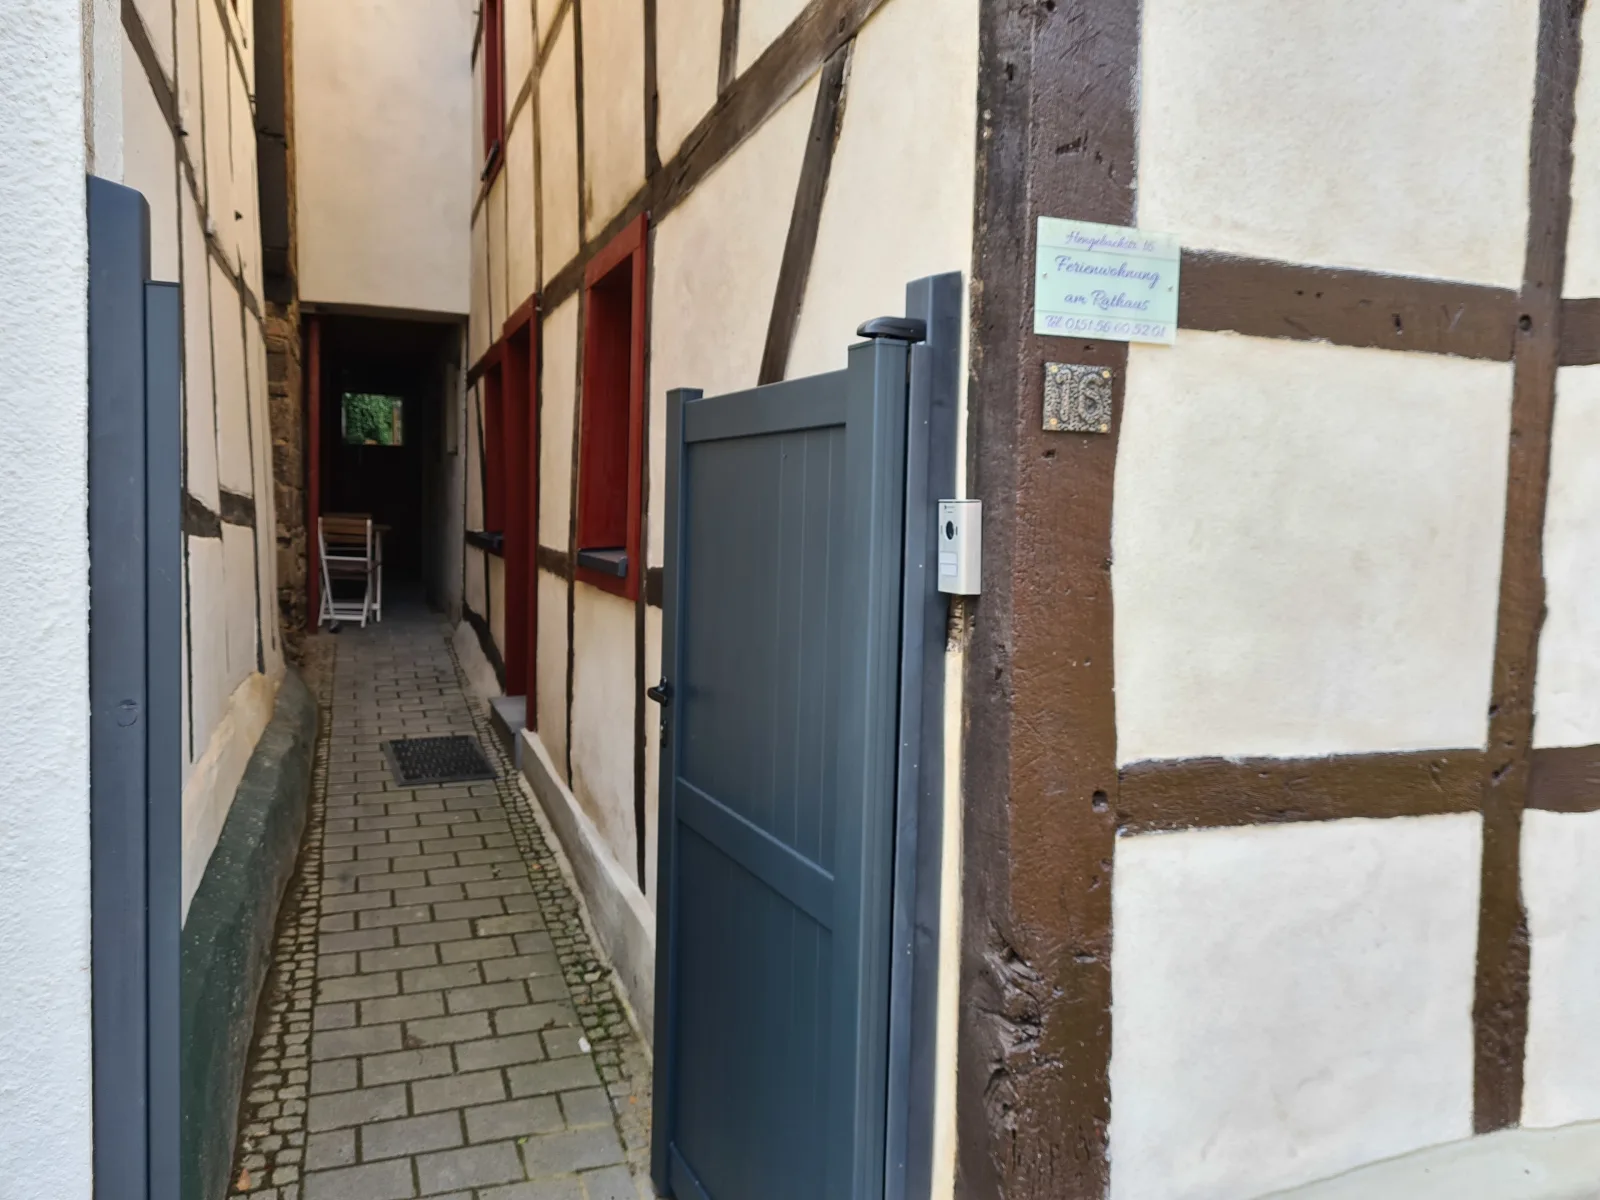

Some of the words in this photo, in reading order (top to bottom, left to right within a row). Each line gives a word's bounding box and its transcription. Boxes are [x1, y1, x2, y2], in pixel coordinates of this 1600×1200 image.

[1055, 255, 1161, 289] Ferienwohnung
[1064, 293, 1087, 304] am
[1091, 289, 1151, 311] Rathaus
[1056, 369, 1104, 424] 16
